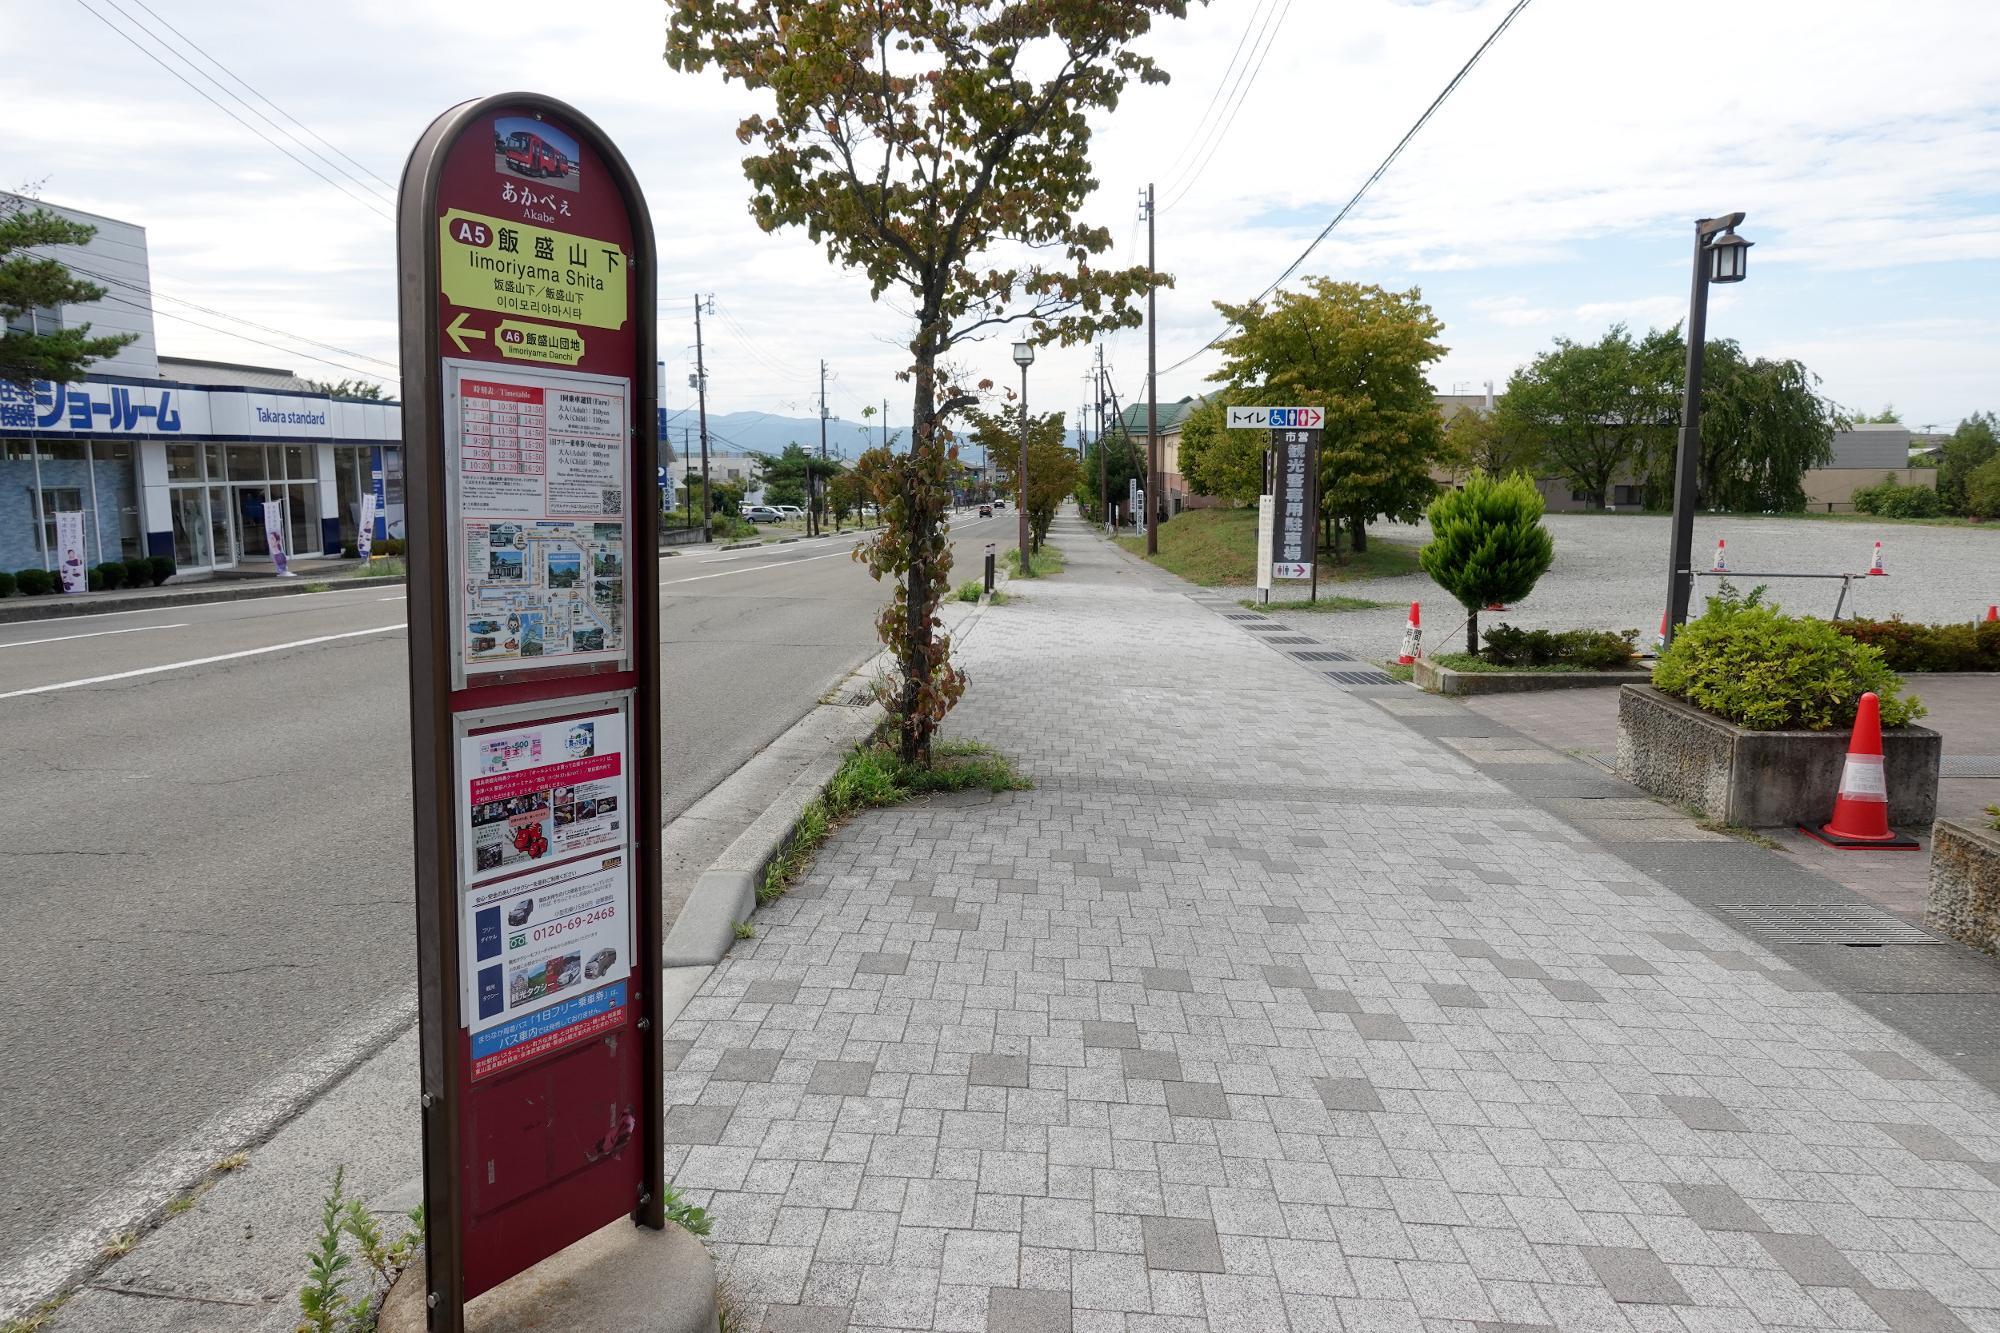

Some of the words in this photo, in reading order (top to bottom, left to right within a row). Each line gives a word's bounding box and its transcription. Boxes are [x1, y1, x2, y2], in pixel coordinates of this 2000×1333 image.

[523, 209, 555, 224] Akabe
[459, 223, 485, 244] A5
[498, 227, 619, 274] 飯盛山下
[470, 251, 559, 283] Iimoriyama
[566, 269, 603, 290] Shita
[497, 296, 582, 319] 이이모리야마시타
[506, 331, 520, 343] A6
[526, 332, 580, 352] 飯盛山団地
[509, 346, 547, 358] Iimoriyama
[549, 350, 573, 361] Danchi
[35, 380, 182, 431] ショールーム
[256, 407, 286, 424] Takara
[287, 411, 325, 425] standard
[1233, 411, 1266, 424] トイレ
[1285, 432, 1309, 443] 市営
[1283, 444, 1306, 561] 観光客専用駐車場
[534, 907, 615, 941] 0120-69-2468
[512, 982, 555, 1002] 観光タクシー
